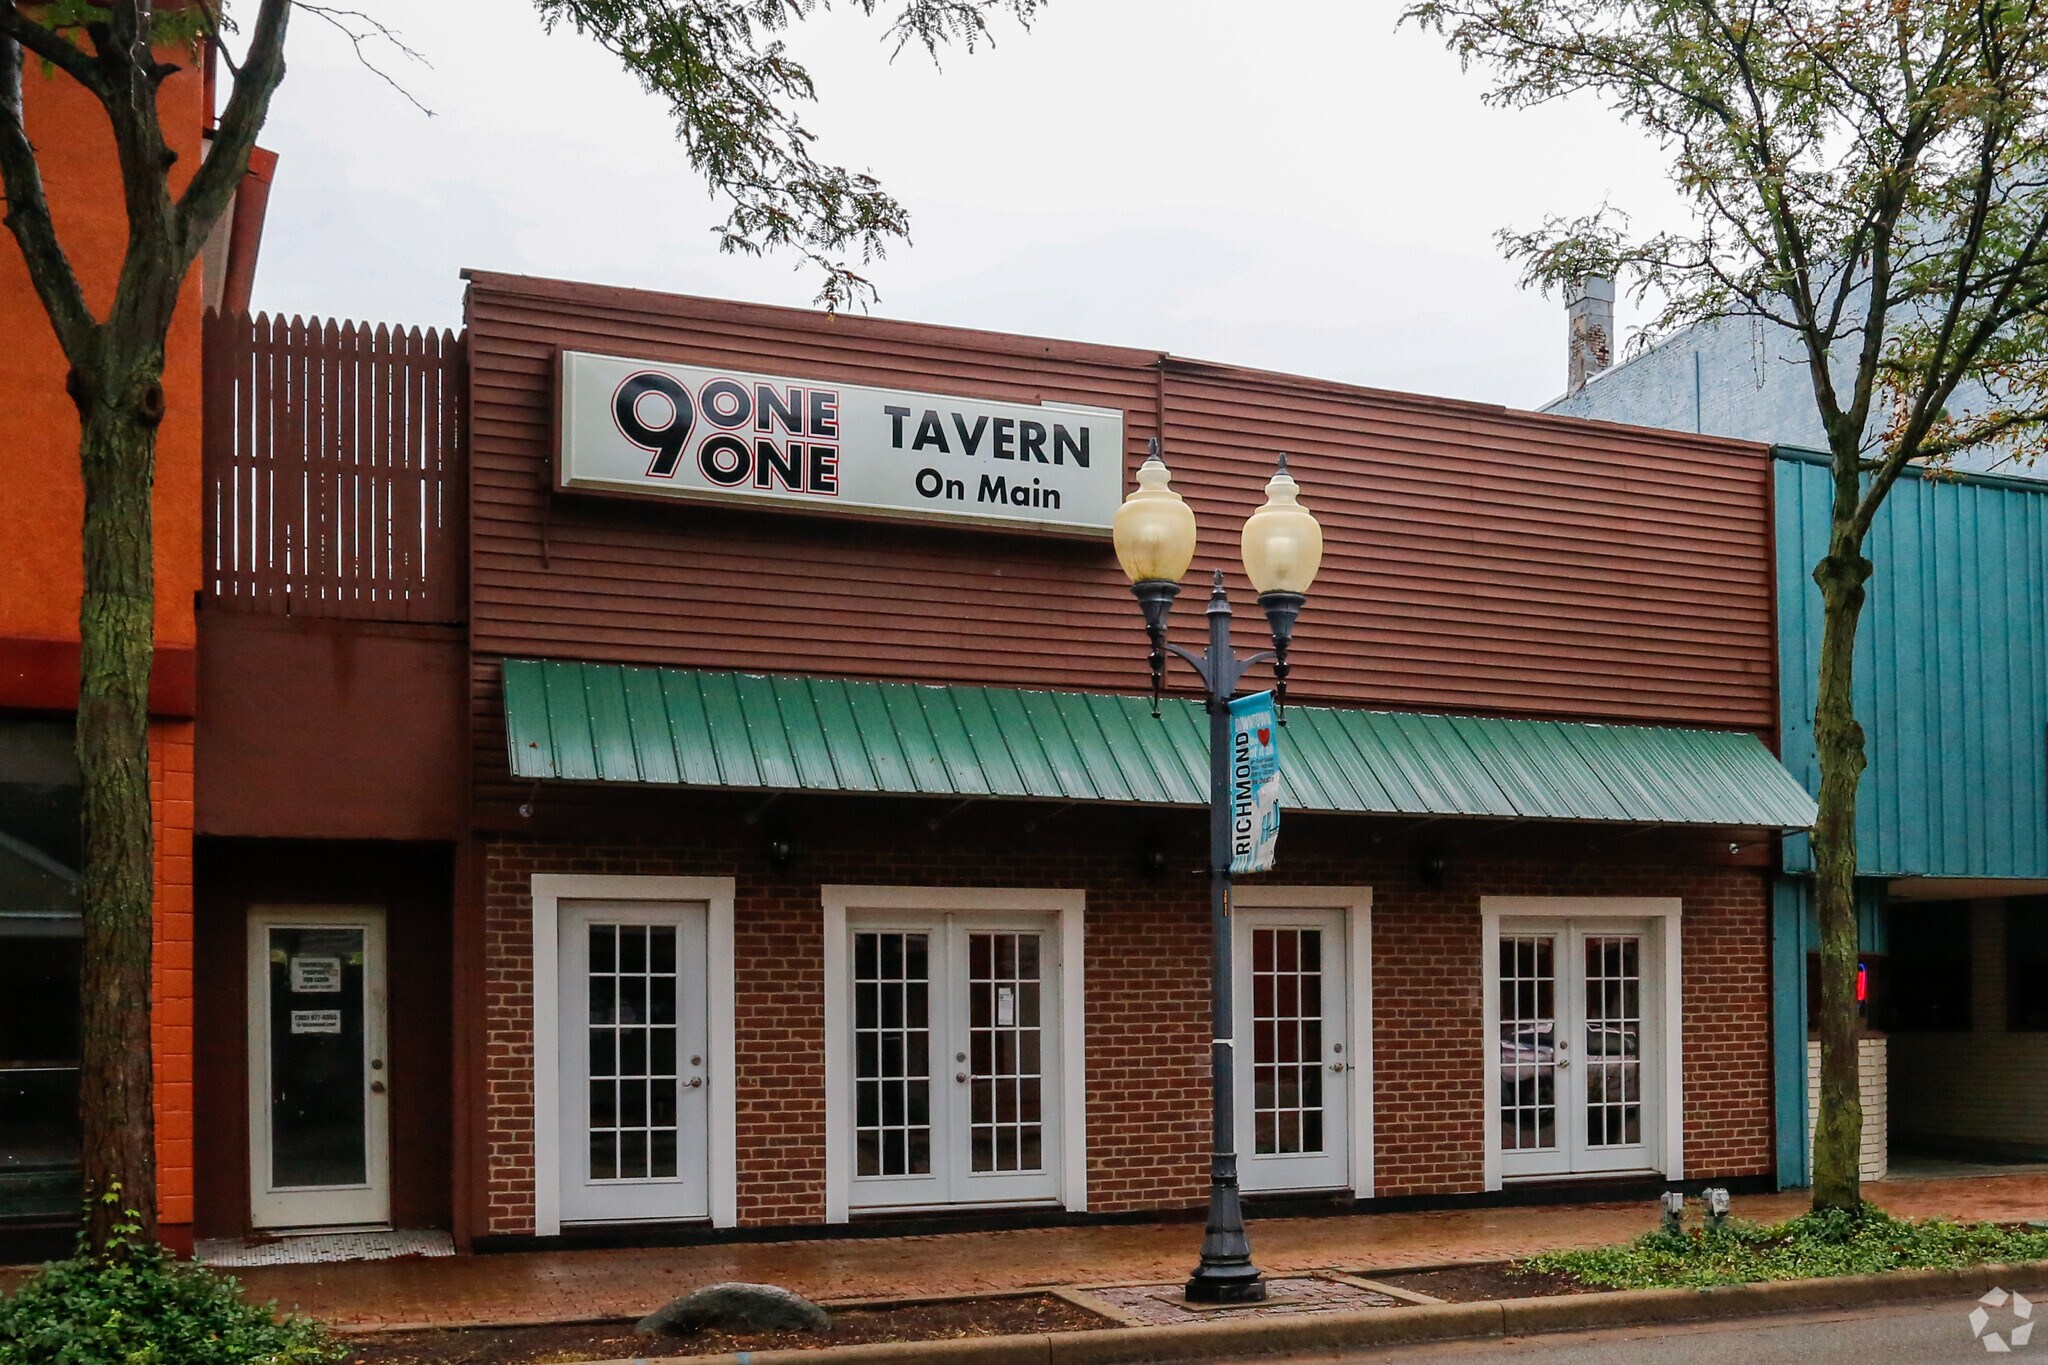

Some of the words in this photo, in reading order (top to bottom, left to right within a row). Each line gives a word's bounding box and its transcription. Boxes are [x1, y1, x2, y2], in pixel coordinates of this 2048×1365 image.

[611, 370, 697, 478] 9
[698, 377, 839, 440] ONE
[884, 405, 1090, 468] TAVERN
[697, 432, 839, 496] ONE
[915, 467, 964, 500] On
[977, 474, 1060, 509] Main
[1235, 731, 1252, 856] RICHMOND
